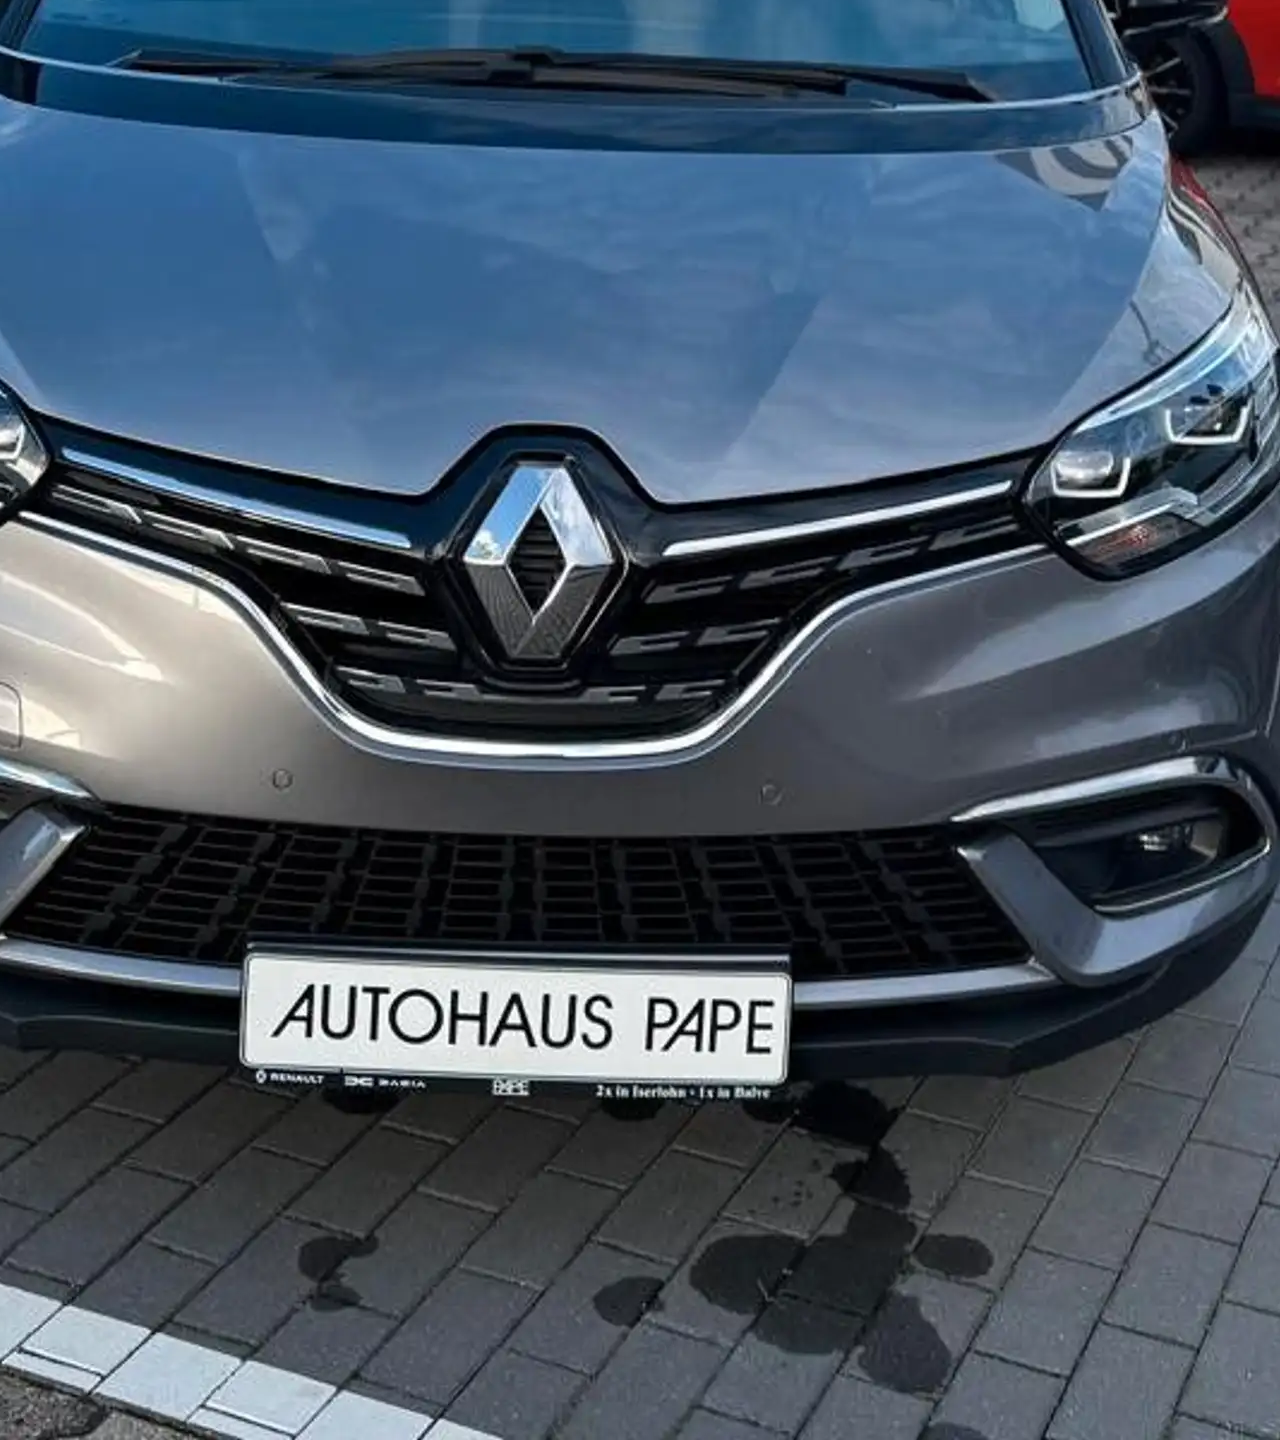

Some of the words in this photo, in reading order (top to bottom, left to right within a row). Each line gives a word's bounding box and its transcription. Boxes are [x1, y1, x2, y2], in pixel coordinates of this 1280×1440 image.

[271, 984, 613, 1050] AUTOHAUS
[645, 997, 775, 1055] PAPE
[270, 1072, 324, 1084] RENAULT
[596, 1084, 612, 1098] 2x
[616, 1085, 629, 1098] in
[632, 1085, 686, 1099] Iserlohn
